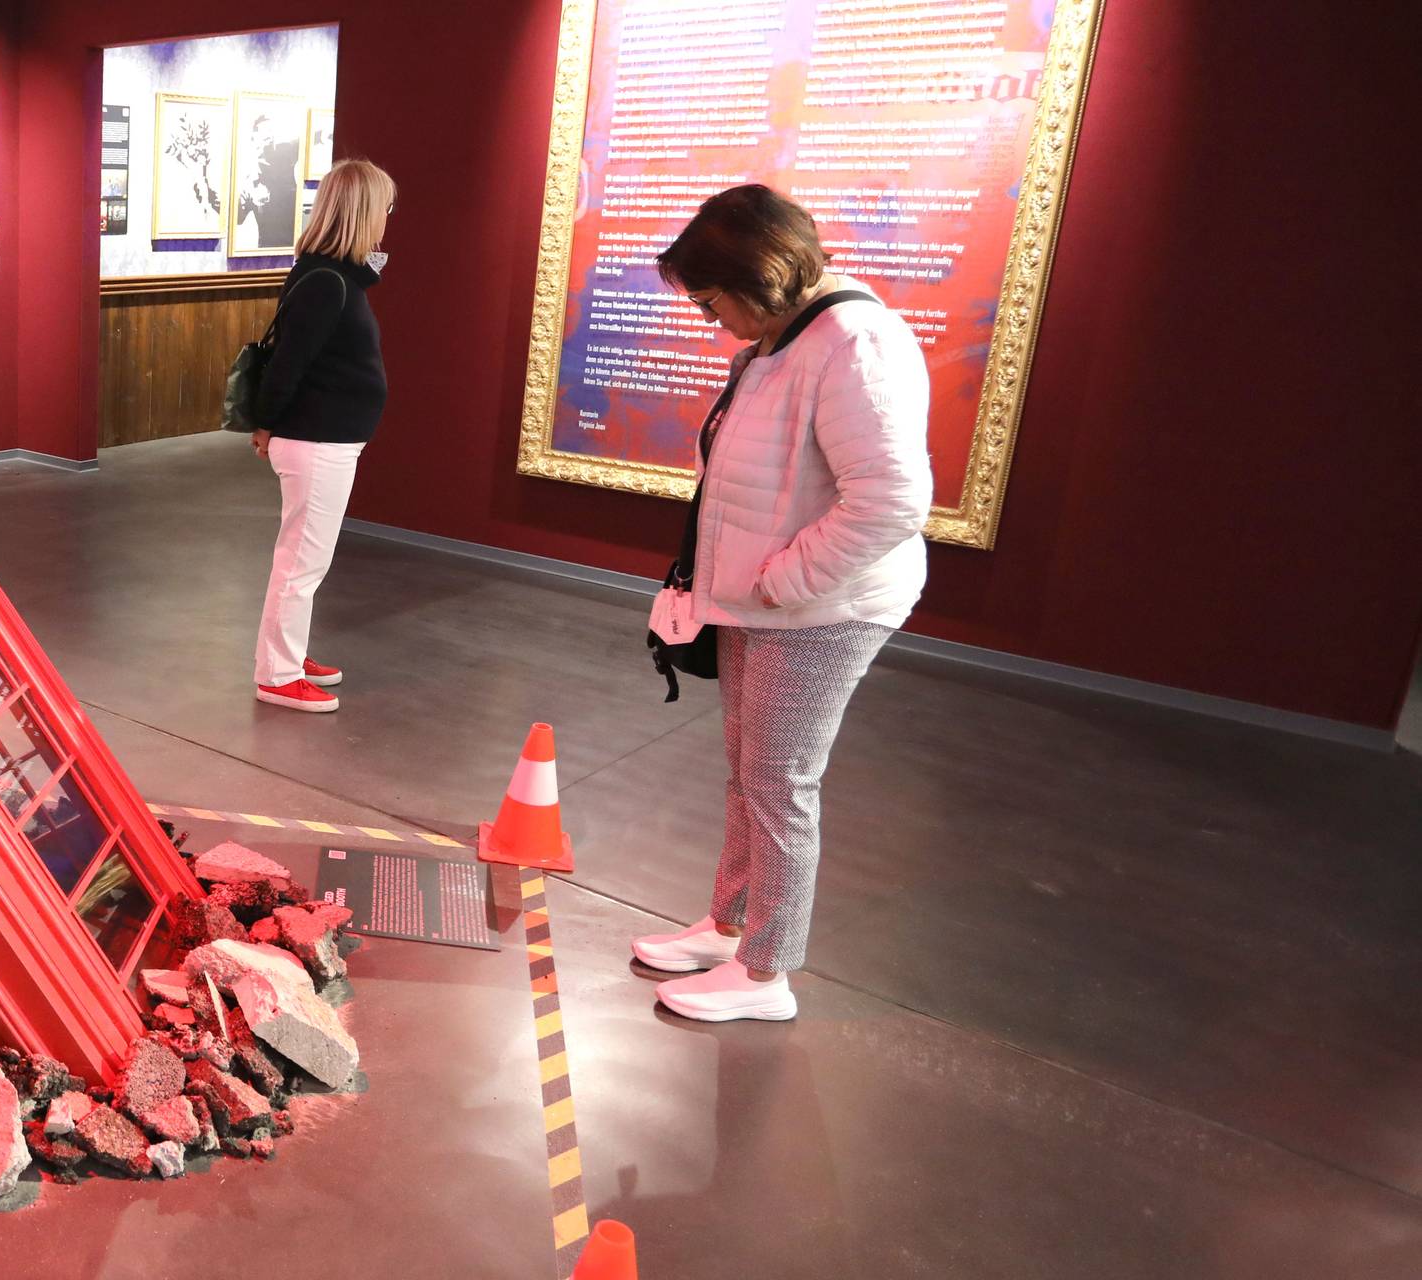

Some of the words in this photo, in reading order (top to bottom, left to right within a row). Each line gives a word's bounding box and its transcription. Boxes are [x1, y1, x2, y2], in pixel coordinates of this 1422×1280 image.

[915, 311, 926, 319] any
[926, 309, 947, 318] further
[934, 323, 946, 331] text
[924, 336, 936, 344] and
